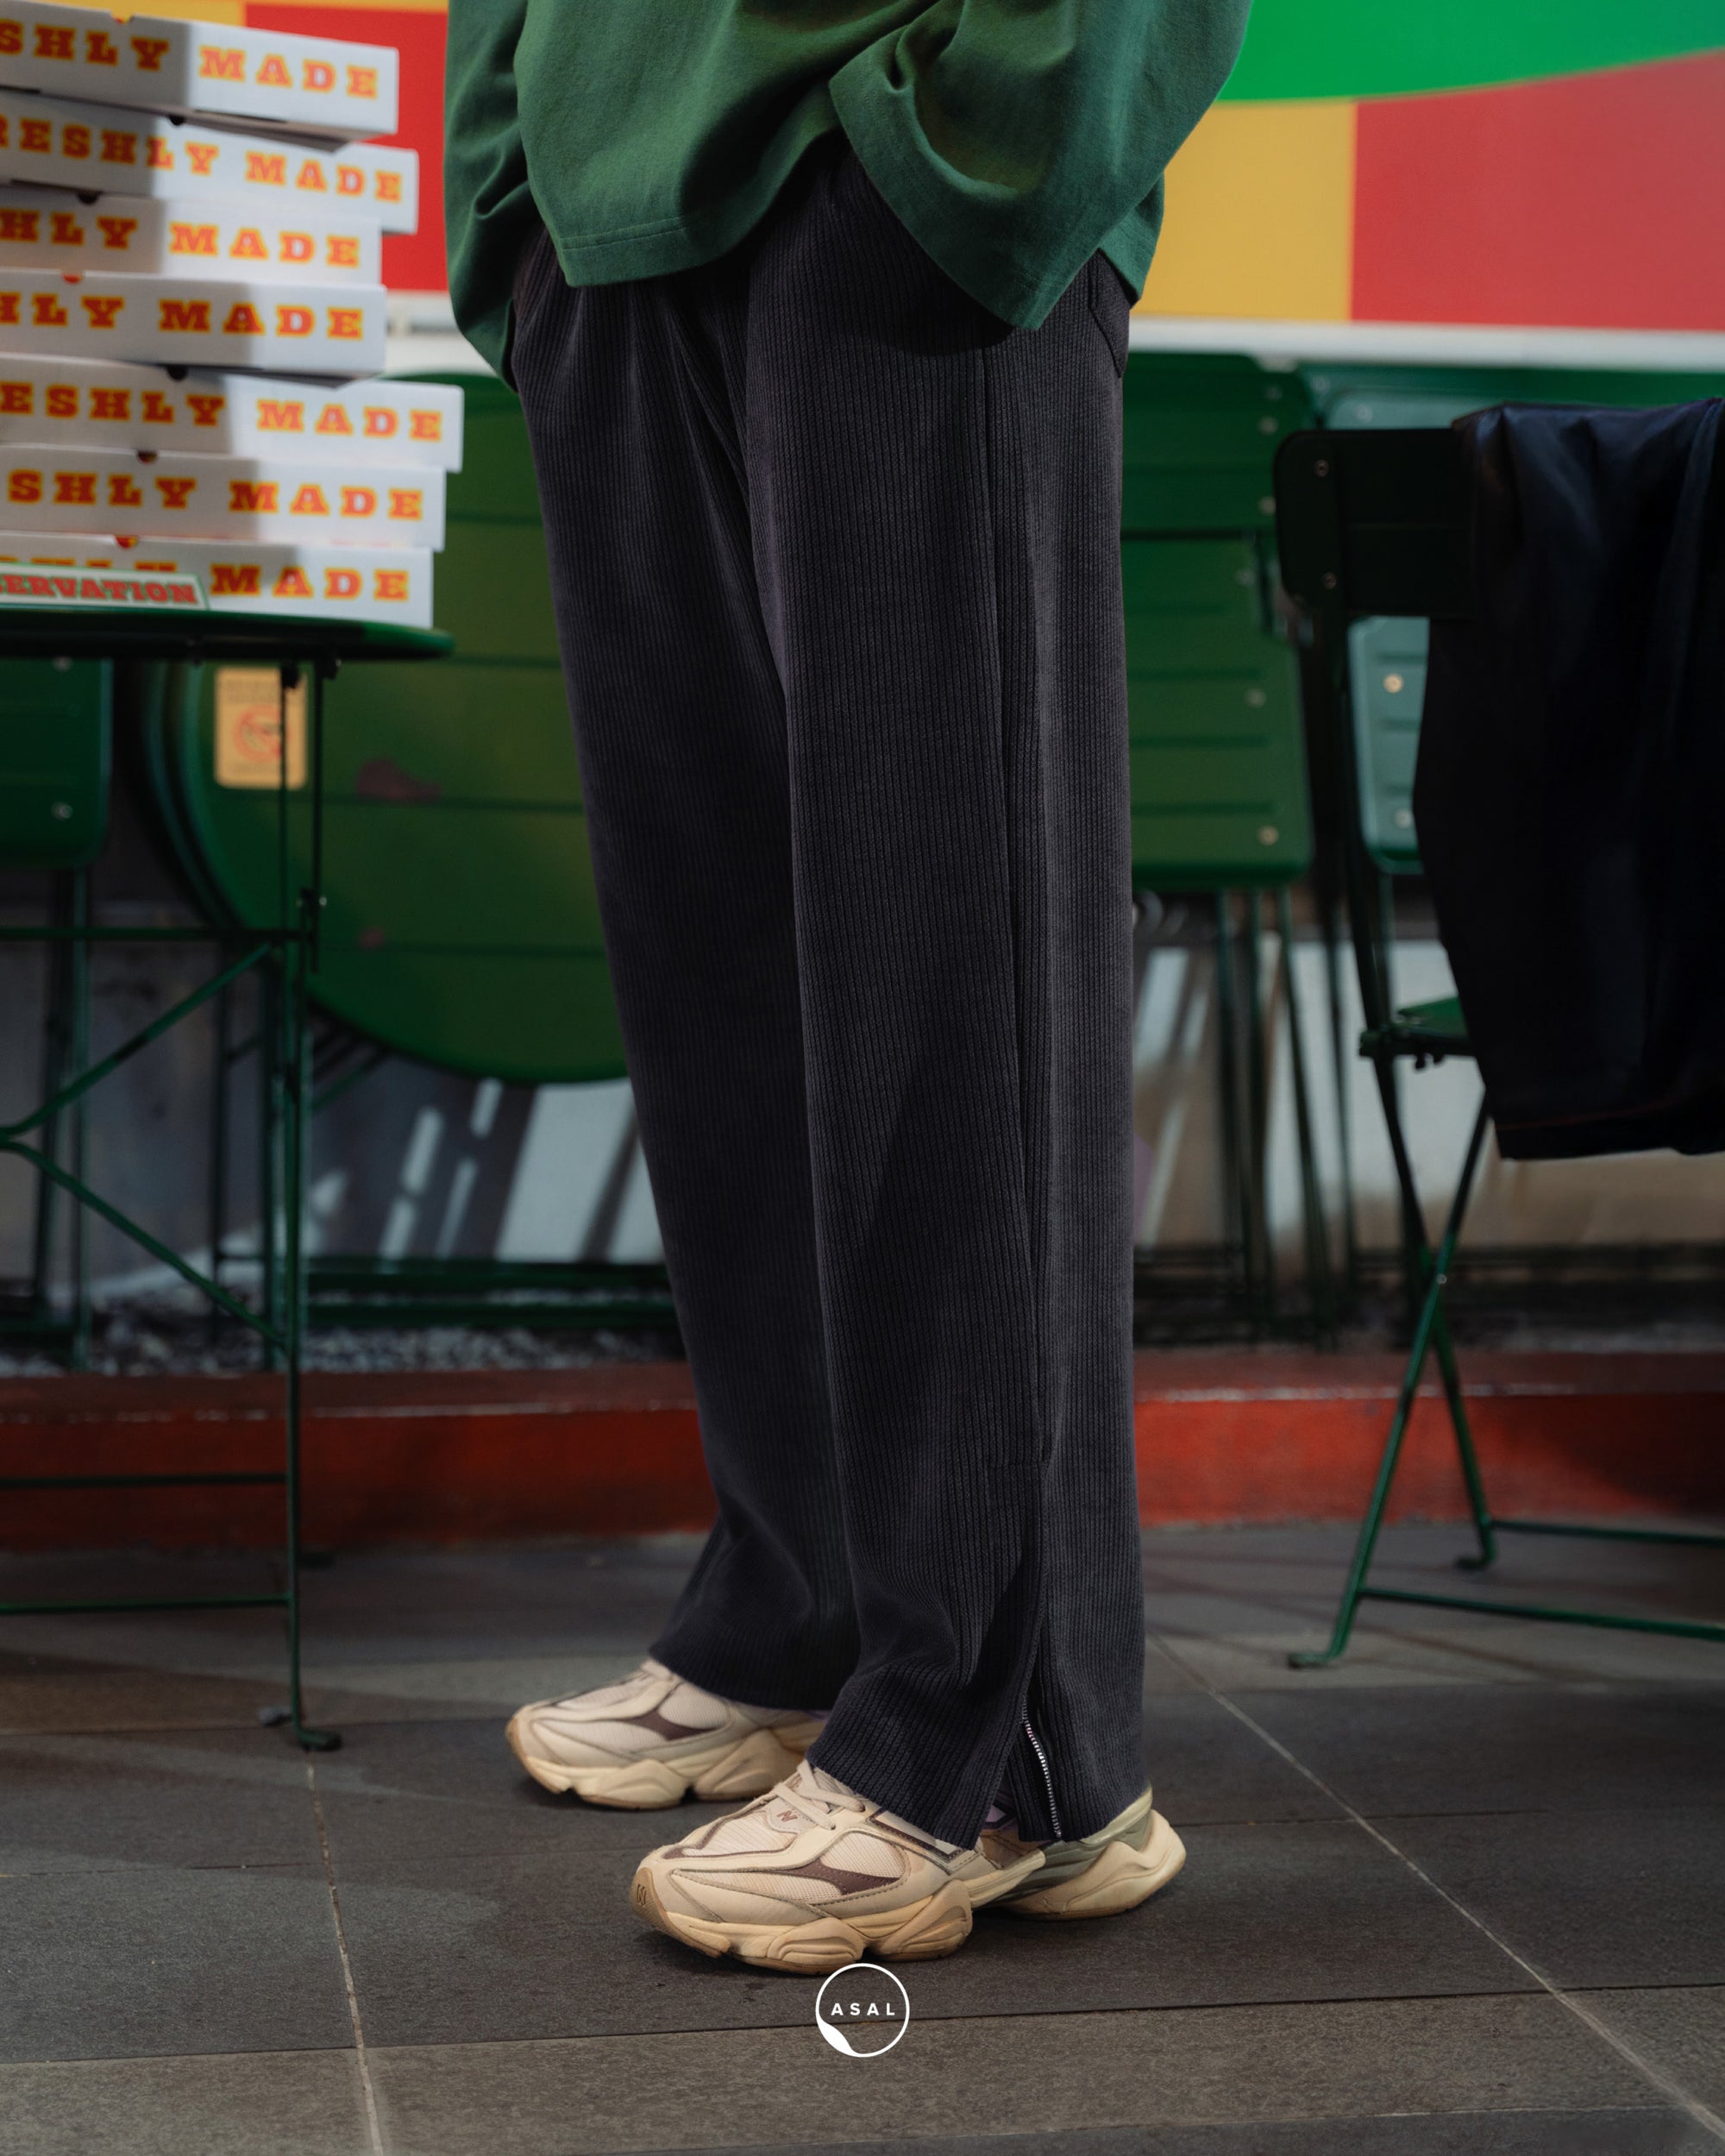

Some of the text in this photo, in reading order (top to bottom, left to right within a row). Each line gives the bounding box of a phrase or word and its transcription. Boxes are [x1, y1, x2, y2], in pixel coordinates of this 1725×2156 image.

[0, 19, 378, 99] SHLY MADE
[0, 114, 402, 203] ESHLY MADE
[0, 209, 359, 268] HLY MADE
[159, 299, 363, 340] MADE
[0, 381, 442, 441] ESHLY MADE
[8, 468, 422, 520] SHLY MADE
[0, 574, 198, 604] ERVATION
[210, 563, 409, 601] MADE
